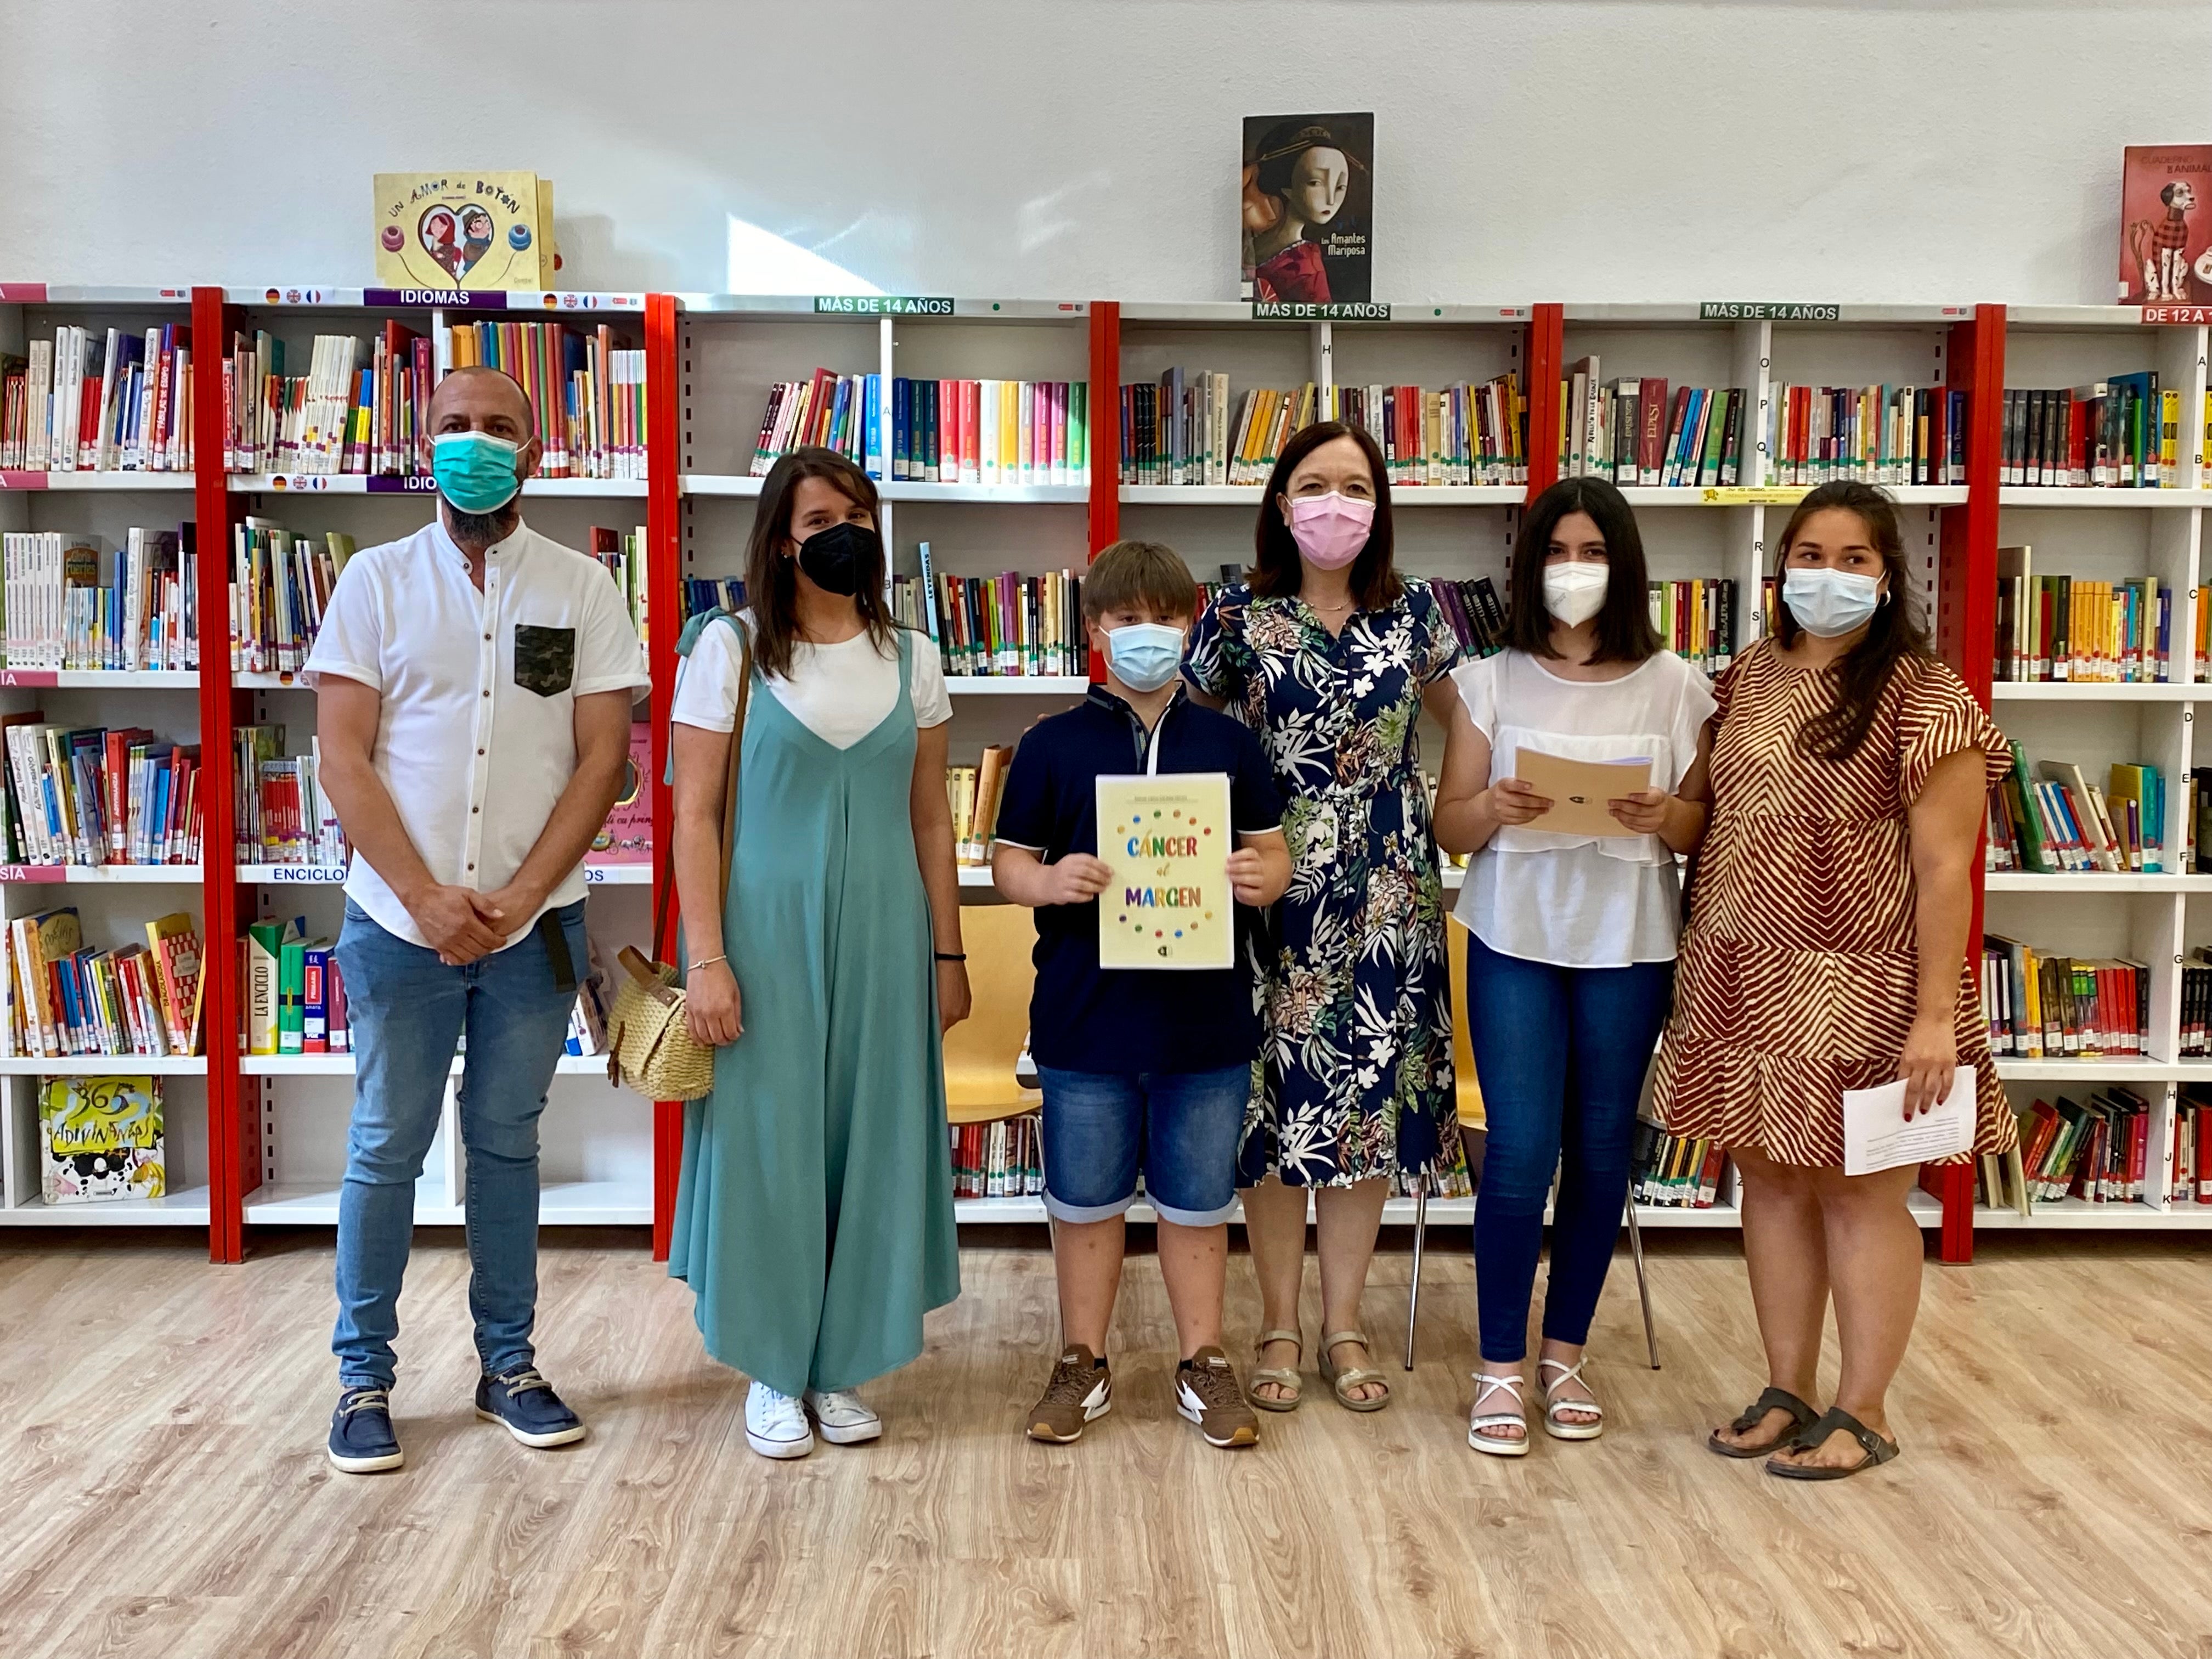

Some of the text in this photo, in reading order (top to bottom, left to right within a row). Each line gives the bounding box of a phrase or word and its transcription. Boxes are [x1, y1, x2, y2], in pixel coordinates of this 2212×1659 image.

[2174, 165, 2212, 173] ANIMAL
[388, 201, 404, 218] UN
[410, 179, 448, 204] AMOR
[1331, 233, 1365, 245] Amantes
[1328, 245, 1365, 257] Mariposa
[400, 290, 470, 305] IDIOMAS
[819, 296, 951, 314] MÁS DE 14 AÑOS
[1257, 302, 1388, 318] MÁS DE 14 AÑOS
[1705, 303, 1837, 320] MÁS DE 14 AÑOS
[2146, 308, 2168, 321] DE
[2171, 308, 2190, 321] 12
[2193, 308, 2205, 322] A
[1322, 345, 1331, 355] H
[2197, 357, 2207, 366] A
[1760, 399, 1768, 409] P
[1756, 442, 1768, 453] Q
[2194, 454, 2203, 464] B
[404, 476, 437, 490] IDIO
[1754, 541, 1763, 551] R
[924, 553, 934, 600] LEYENDAS
[2188, 589, 2198, 599] C
[1752, 611, 1760, 622] S
[2184, 712, 2193, 723] D
[2182, 773, 2190, 783] E
[1127, 829, 1198, 857] CÁNCER
[2179, 851, 2187, 862] F
[0, 865, 26, 880] SÍA
[274, 867, 348, 881] ENCICLO
[1156, 862, 1170, 877] al
[1125, 887, 1201, 908] MARGEN
[2174, 953, 2183, 963] G
[254, 966, 269, 1017] LA ENCICLO
[70, 1081, 136, 1120] 365
[2168, 1090, 2176, 1100] H
[54, 1117, 151, 1148] ADIVINANZAS
[2162, 1194, 2171, 1204] K
